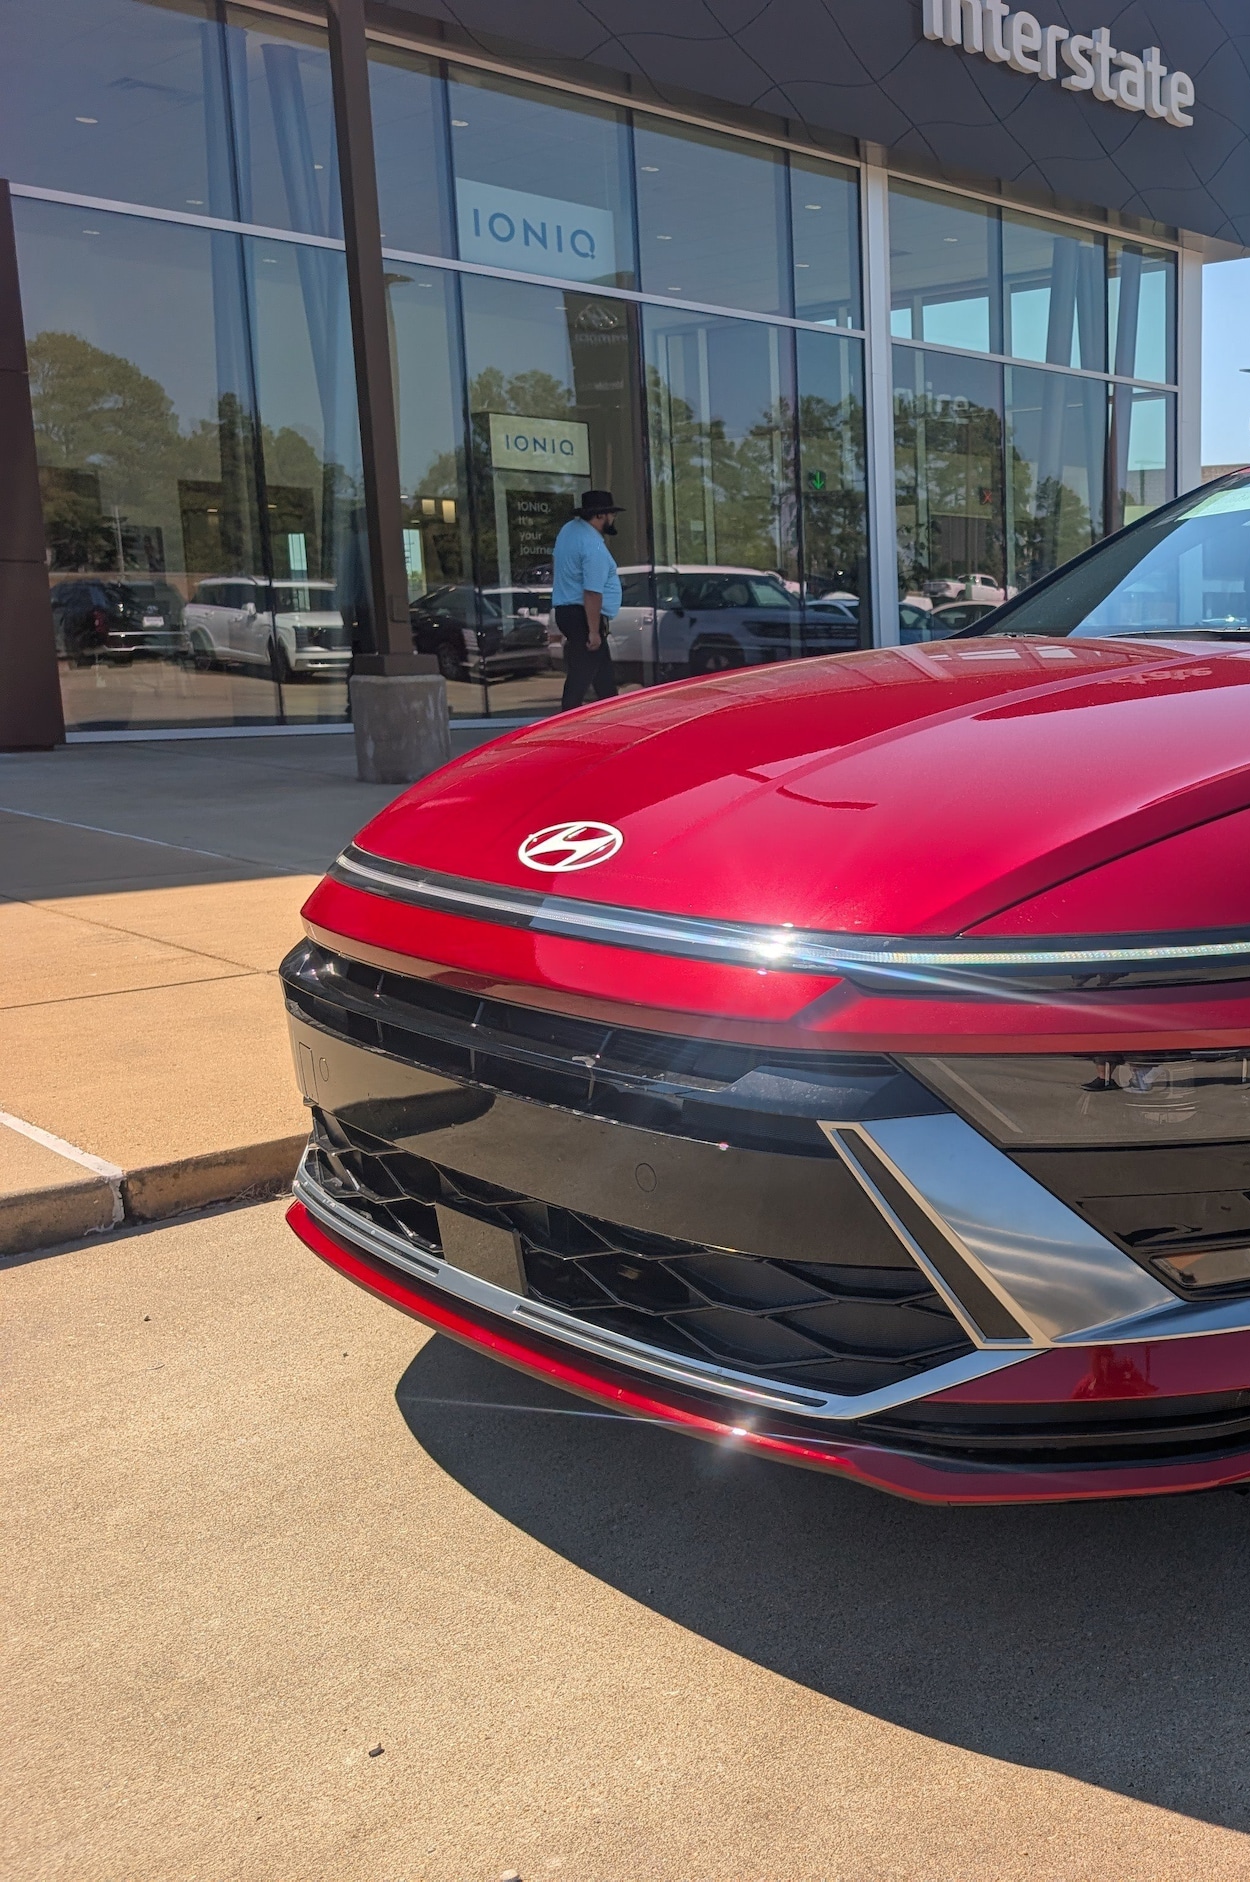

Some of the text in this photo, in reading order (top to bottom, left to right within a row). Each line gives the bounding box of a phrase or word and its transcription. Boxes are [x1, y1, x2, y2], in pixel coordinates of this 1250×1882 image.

[473, 208, 596, 259] IONIQ
[505, 434, 574, 456] IONIQ
[520, 532, 542, 541] your
[520, 544, 555, 556] journe
